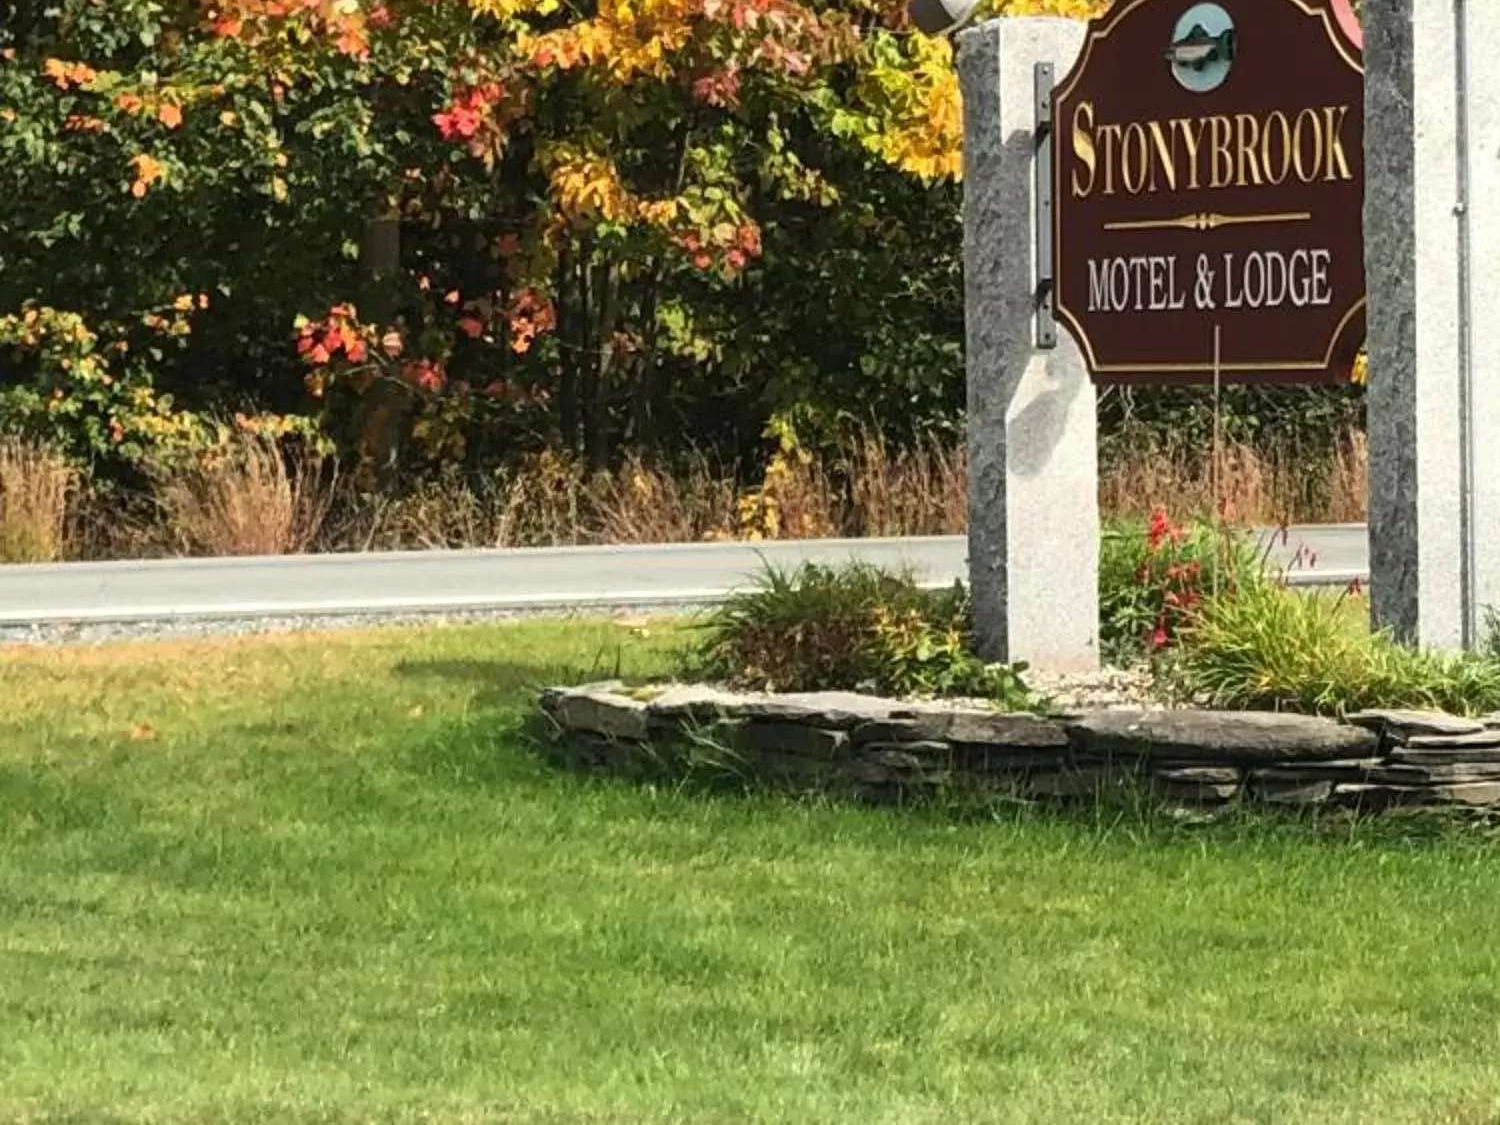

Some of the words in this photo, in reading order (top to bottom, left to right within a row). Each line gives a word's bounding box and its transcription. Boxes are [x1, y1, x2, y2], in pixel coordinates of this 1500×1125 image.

[1072, 102, 1352, 197] STONYBROOK
[1087, 255, 1186, 312] MOTEL
[1194, 254, 1216, 309] &
[1223, 249, 1332, 308] LODGE
